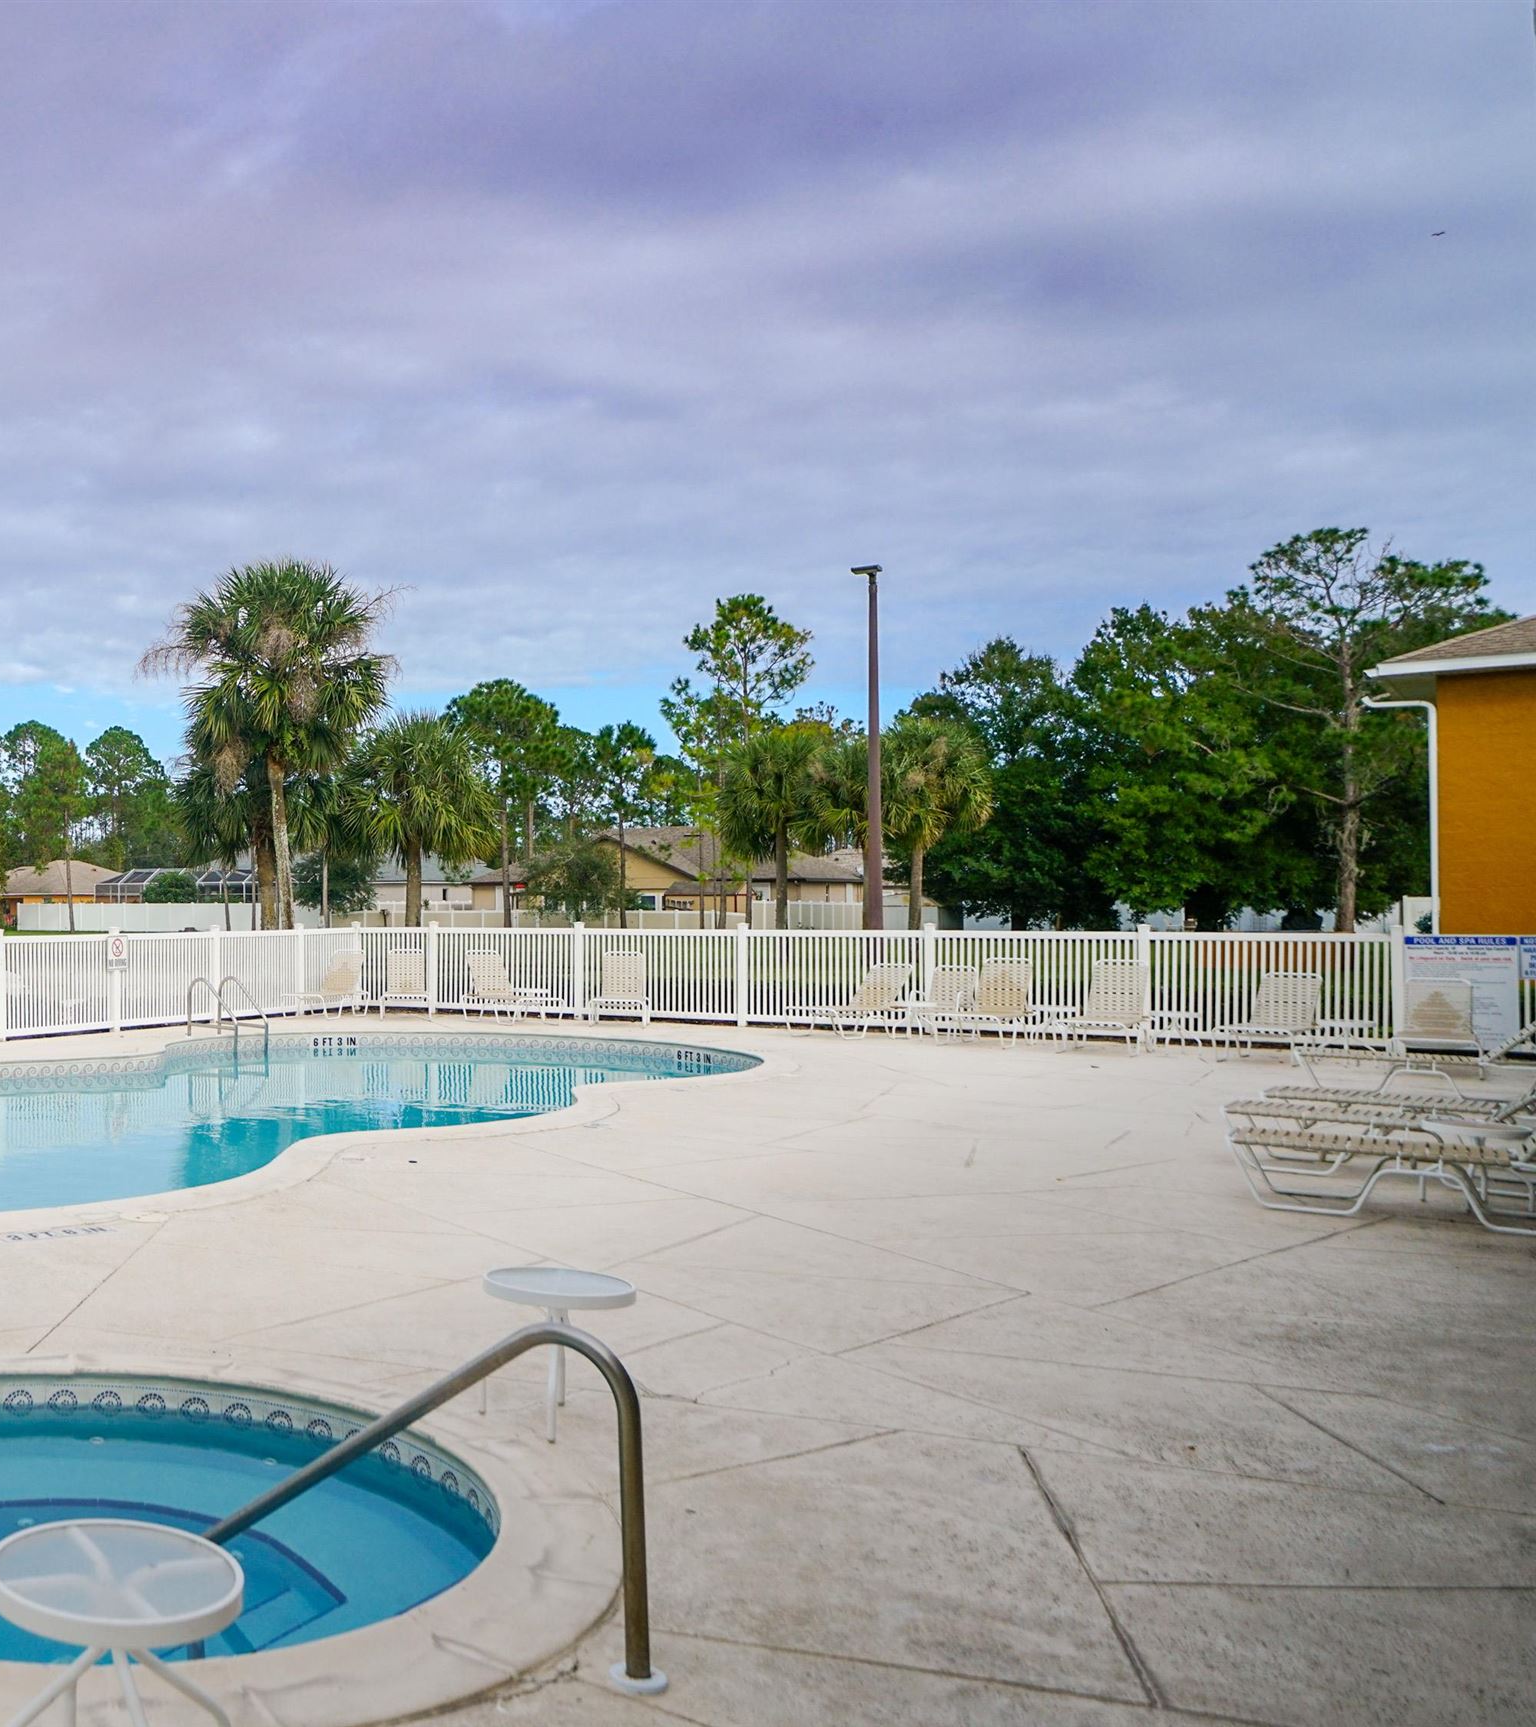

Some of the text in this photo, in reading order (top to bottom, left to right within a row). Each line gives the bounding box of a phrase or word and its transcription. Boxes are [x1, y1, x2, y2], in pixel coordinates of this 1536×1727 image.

[1413, 937, 1507, 945] POOL AND SPA RULES
[313, 1038, 318, 1046] 6
[337, 1037, 342, 1046] 3
[677, 1050, 682, 1060] 6
[696, 1052, 700, 1062] 3
